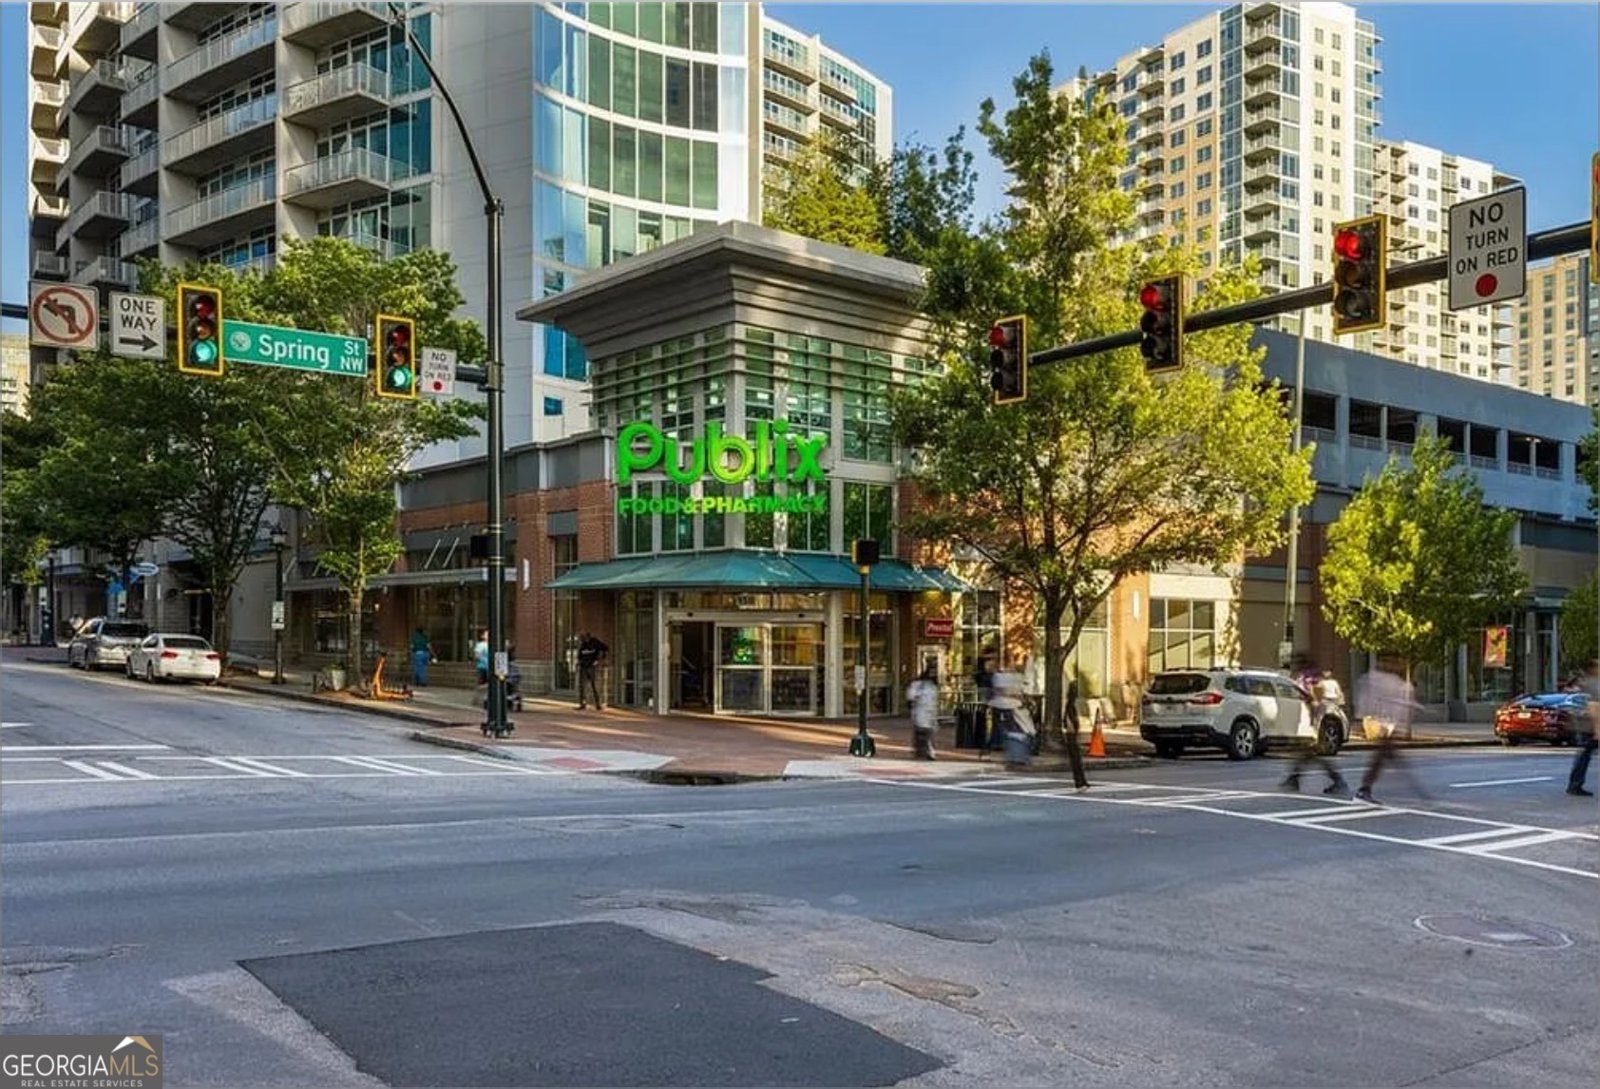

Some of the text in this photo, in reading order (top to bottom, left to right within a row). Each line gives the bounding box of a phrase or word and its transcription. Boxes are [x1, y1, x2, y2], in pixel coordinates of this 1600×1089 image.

[1470, 202, 1503, 228] NO
[1466, 226, 1509, 250] TURN
[1456, 247, 1518, 275] ON RED
[120, 297, 156, 315] ONE
[121, 313, 156, 331] WAY
[258, 333, 359, 369] Spring St
[431, 352, 447, 362] NO
[340, 355, 363, 372] NW
[617, 418, 828, 486] Publix
